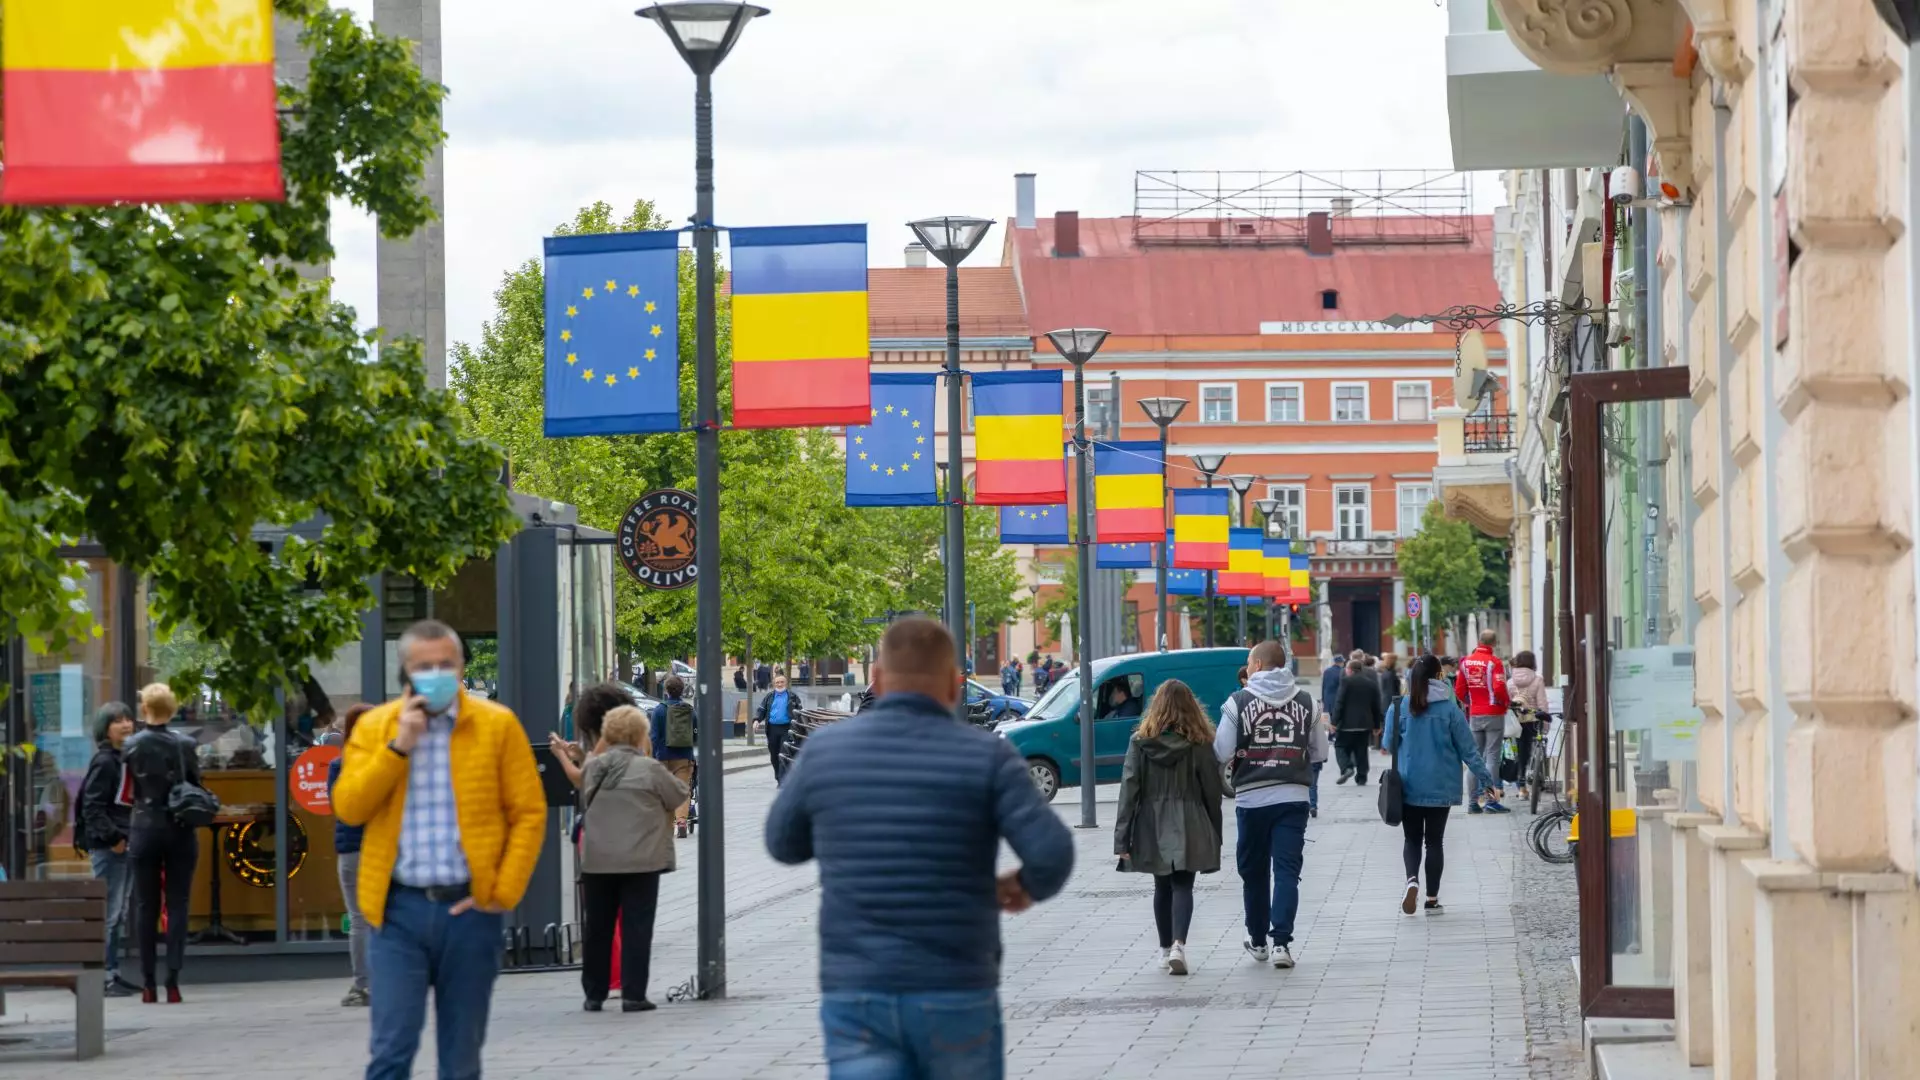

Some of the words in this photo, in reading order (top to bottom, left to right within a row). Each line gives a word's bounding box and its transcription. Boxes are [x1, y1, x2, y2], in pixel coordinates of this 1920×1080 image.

[1281, 321, 1413, 332] MDCCCXXVII
[622, 500, 652, 557] COFFEE
[638, 564, 698, 585] OLIVO
